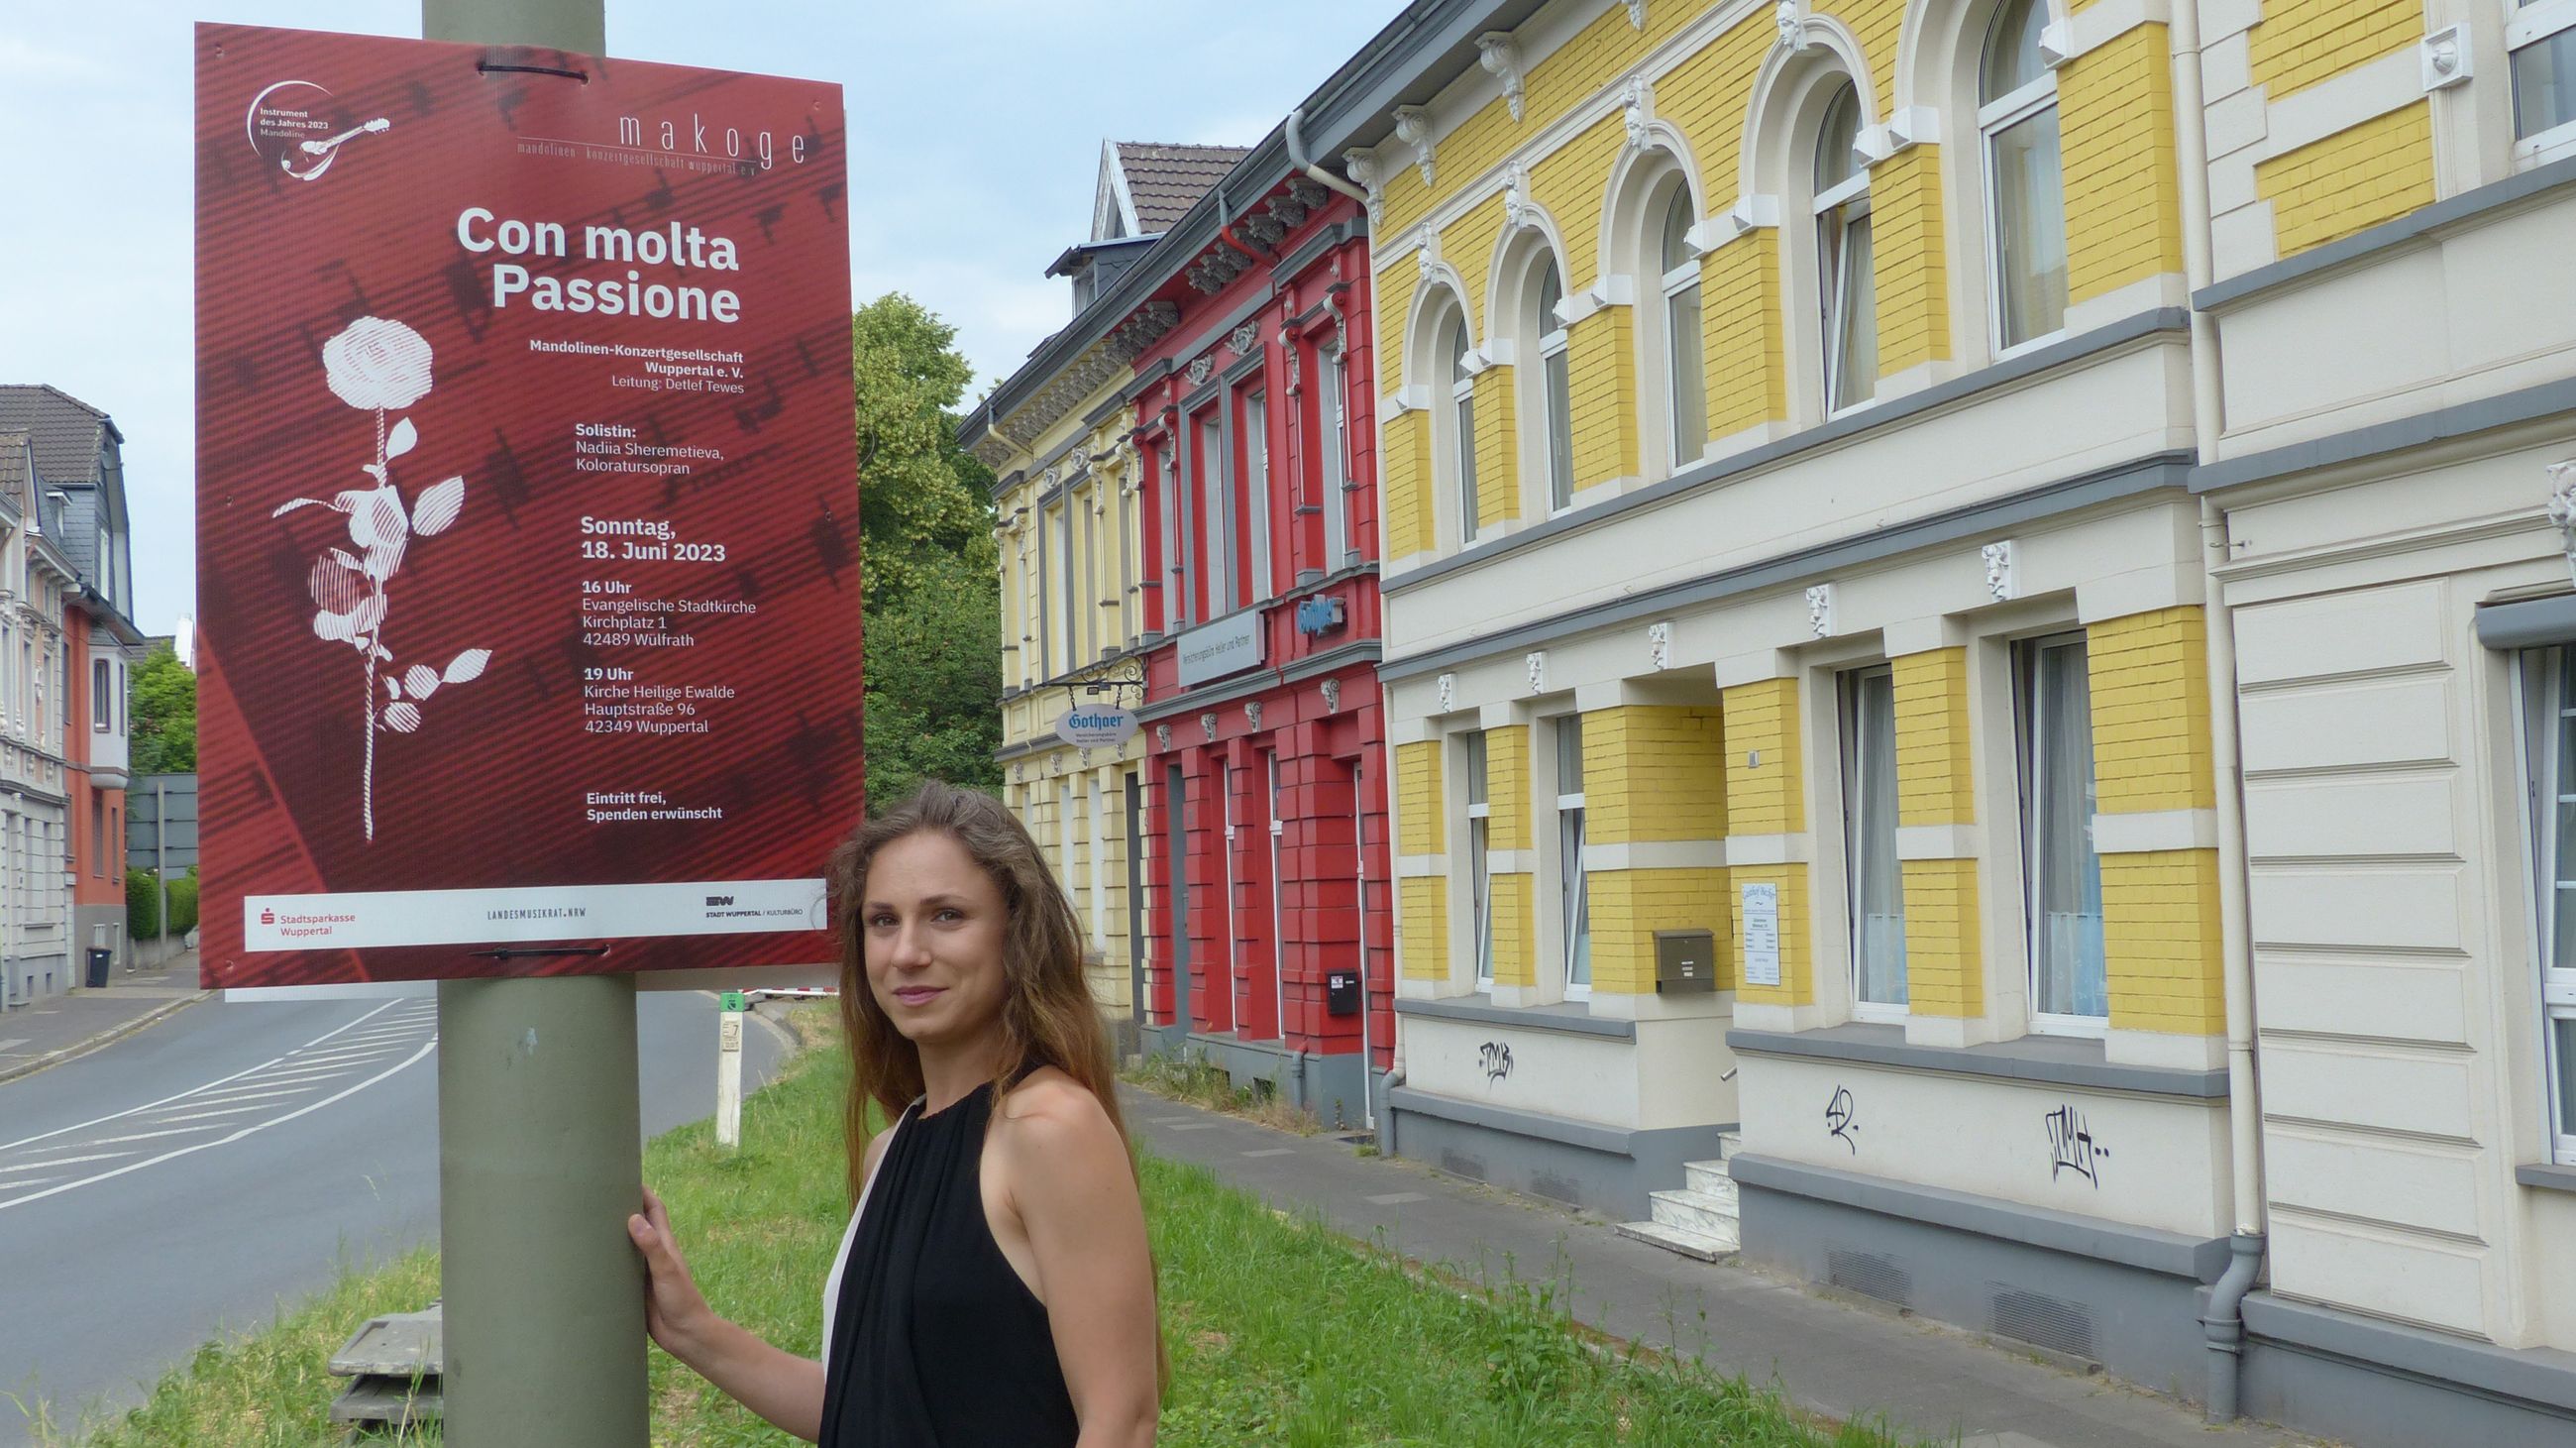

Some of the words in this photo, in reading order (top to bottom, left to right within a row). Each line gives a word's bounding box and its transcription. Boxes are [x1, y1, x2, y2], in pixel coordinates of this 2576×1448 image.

[260, 108, 308, 118] Instrument
[260, 118, 276, 127] des
[277, 119, 306, 129] Jahres
[307, 121, 329, 130] 2023
[260, 129, 306, 139] Mandoline
[619, 113, 805, 169] makoge
[458, 207, 566, 257] Con
[586, 221, 740, 271] molta
[493, 263, 741, 323] Passione
[530, 339, 744, 364] Mandolinen-Konzertgesellschaft
[645, 362, 714, 378] Wuppertal
[716, 368, 728, 378] e.
[731, 367, 744, 379] V.
[611, 375, 663, 391] Leitung:
[666, 378, 703, 391] Detlef
[705, 380, 745, 393] Tewes
[575, 423, 637, 438] Solistin:
[576, 441, 621, 455] Nadiia
[625, 442, 724, 461] Sheremetieva,
[577, 458, 691, 476] Koloratursopran
[581, 515, 677, 540] Sonntag,
[582, 541, 615, 559] 18.
[621, 542, 668, 561] Juni
[673, 543, 726, 562] 2023
[582, 581, 601, 594] 16
[604, 581, 632, 595] Uhr
[583, 598, 675, 614] Evangelische
[678, 600, 757, 613] Stadtkirche
[583, 615, 654, 631] Kirchplatz
[658, 616, 667, 629] 1
[583, 632, 631, 646] 42489
[634, 632, 695, 646] Wülfrath
[584, 667, 603, 681] 19
[606, 667, 634, 681] Uhr
[585, 685, 630, 699] Kirche
[633, 685, 682, 701] Heilige
[685, 686, 735, 699] Ewalde
[585, 703, 674, 718] Hauptstraße
[677, 703, 696, 716] 96
[585, 720, 633, 733] 42349
[636, 720, 709, 735] Wuppertal
[1068, 713, 1124, 730] Gothaer
[587, 792, 636, 805] Eintritt
[638, 791, 667, 806] frei,
[587, 809, 648, 824] Spenden
[651, 807, 722, 820] erwünscht
[280, 913, 356, 925] Stadtsparkasse
[487, 908, 587, 921] LANDESMUSIKRAT.NRW
[280, 926, 333, 938] Wuppertal
